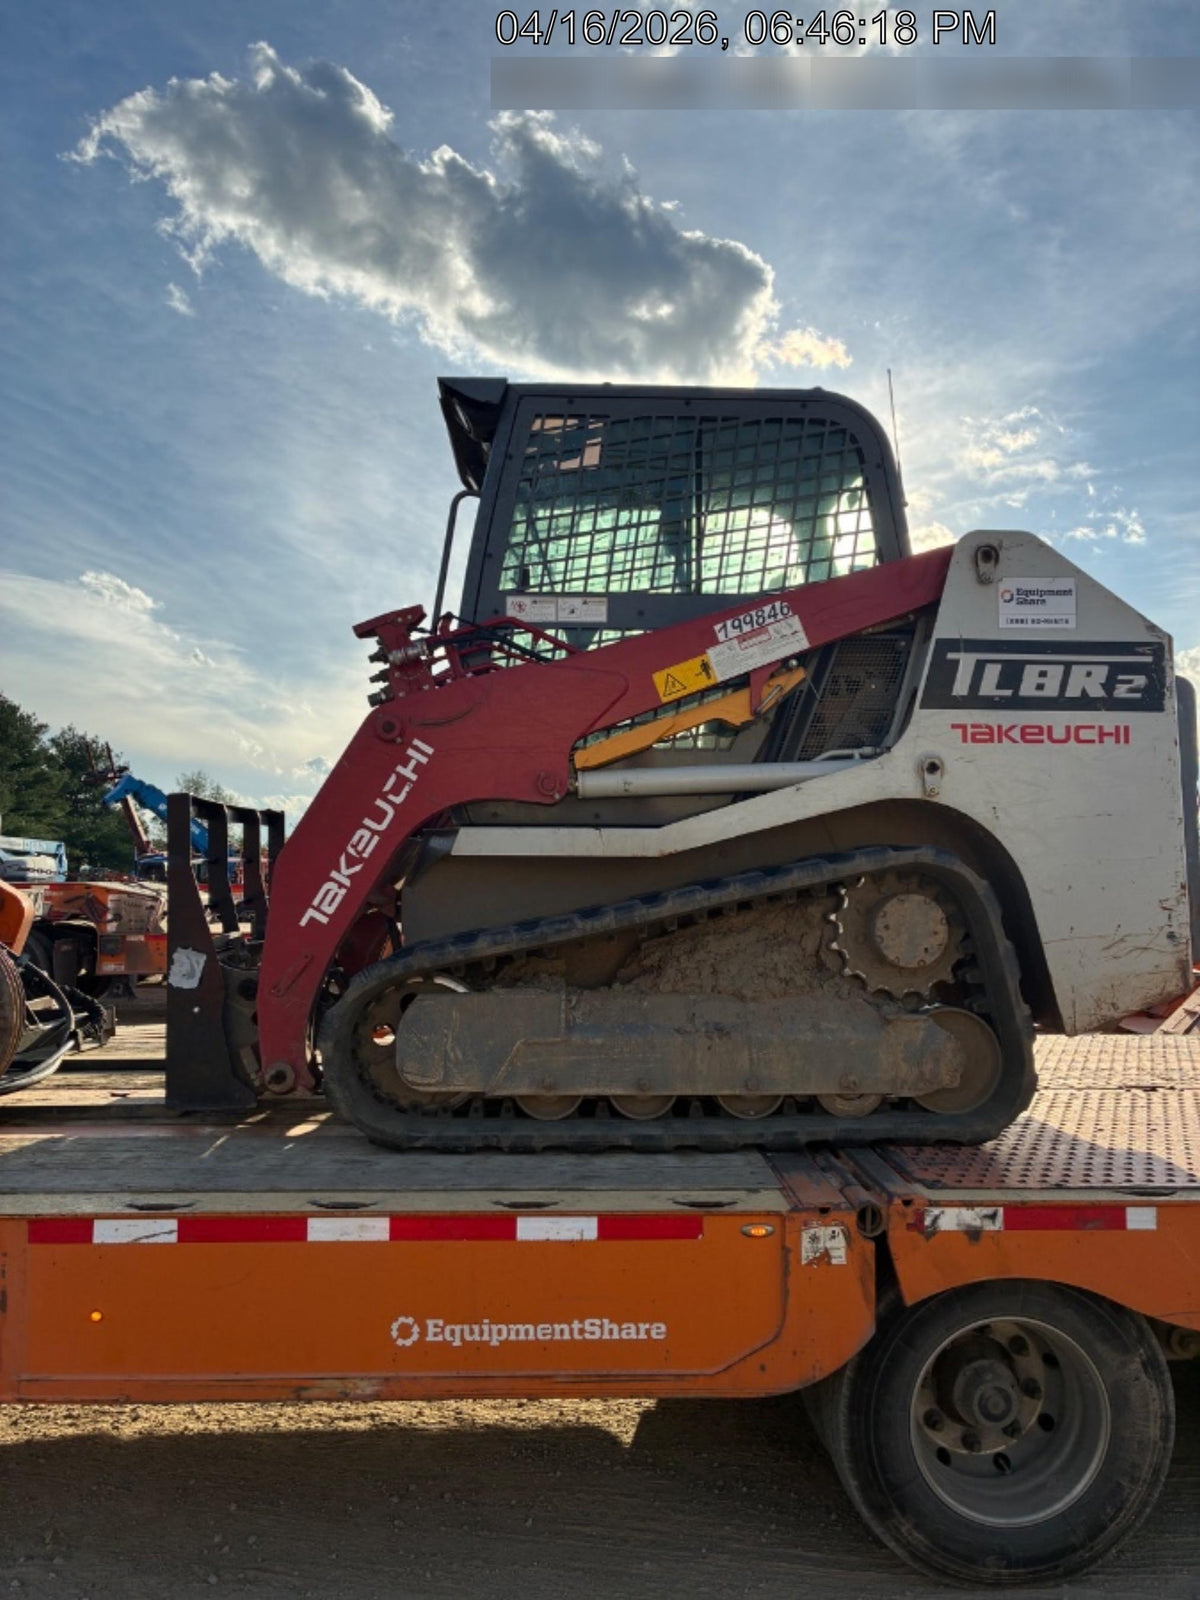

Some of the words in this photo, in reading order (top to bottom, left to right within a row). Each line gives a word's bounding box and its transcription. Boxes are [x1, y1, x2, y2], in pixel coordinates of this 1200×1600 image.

[1016, 588, 1073, 598] Equipment
[718, 601, 791, 638] 199846
[425, 1318, 667, 1346] EquipmentShare
